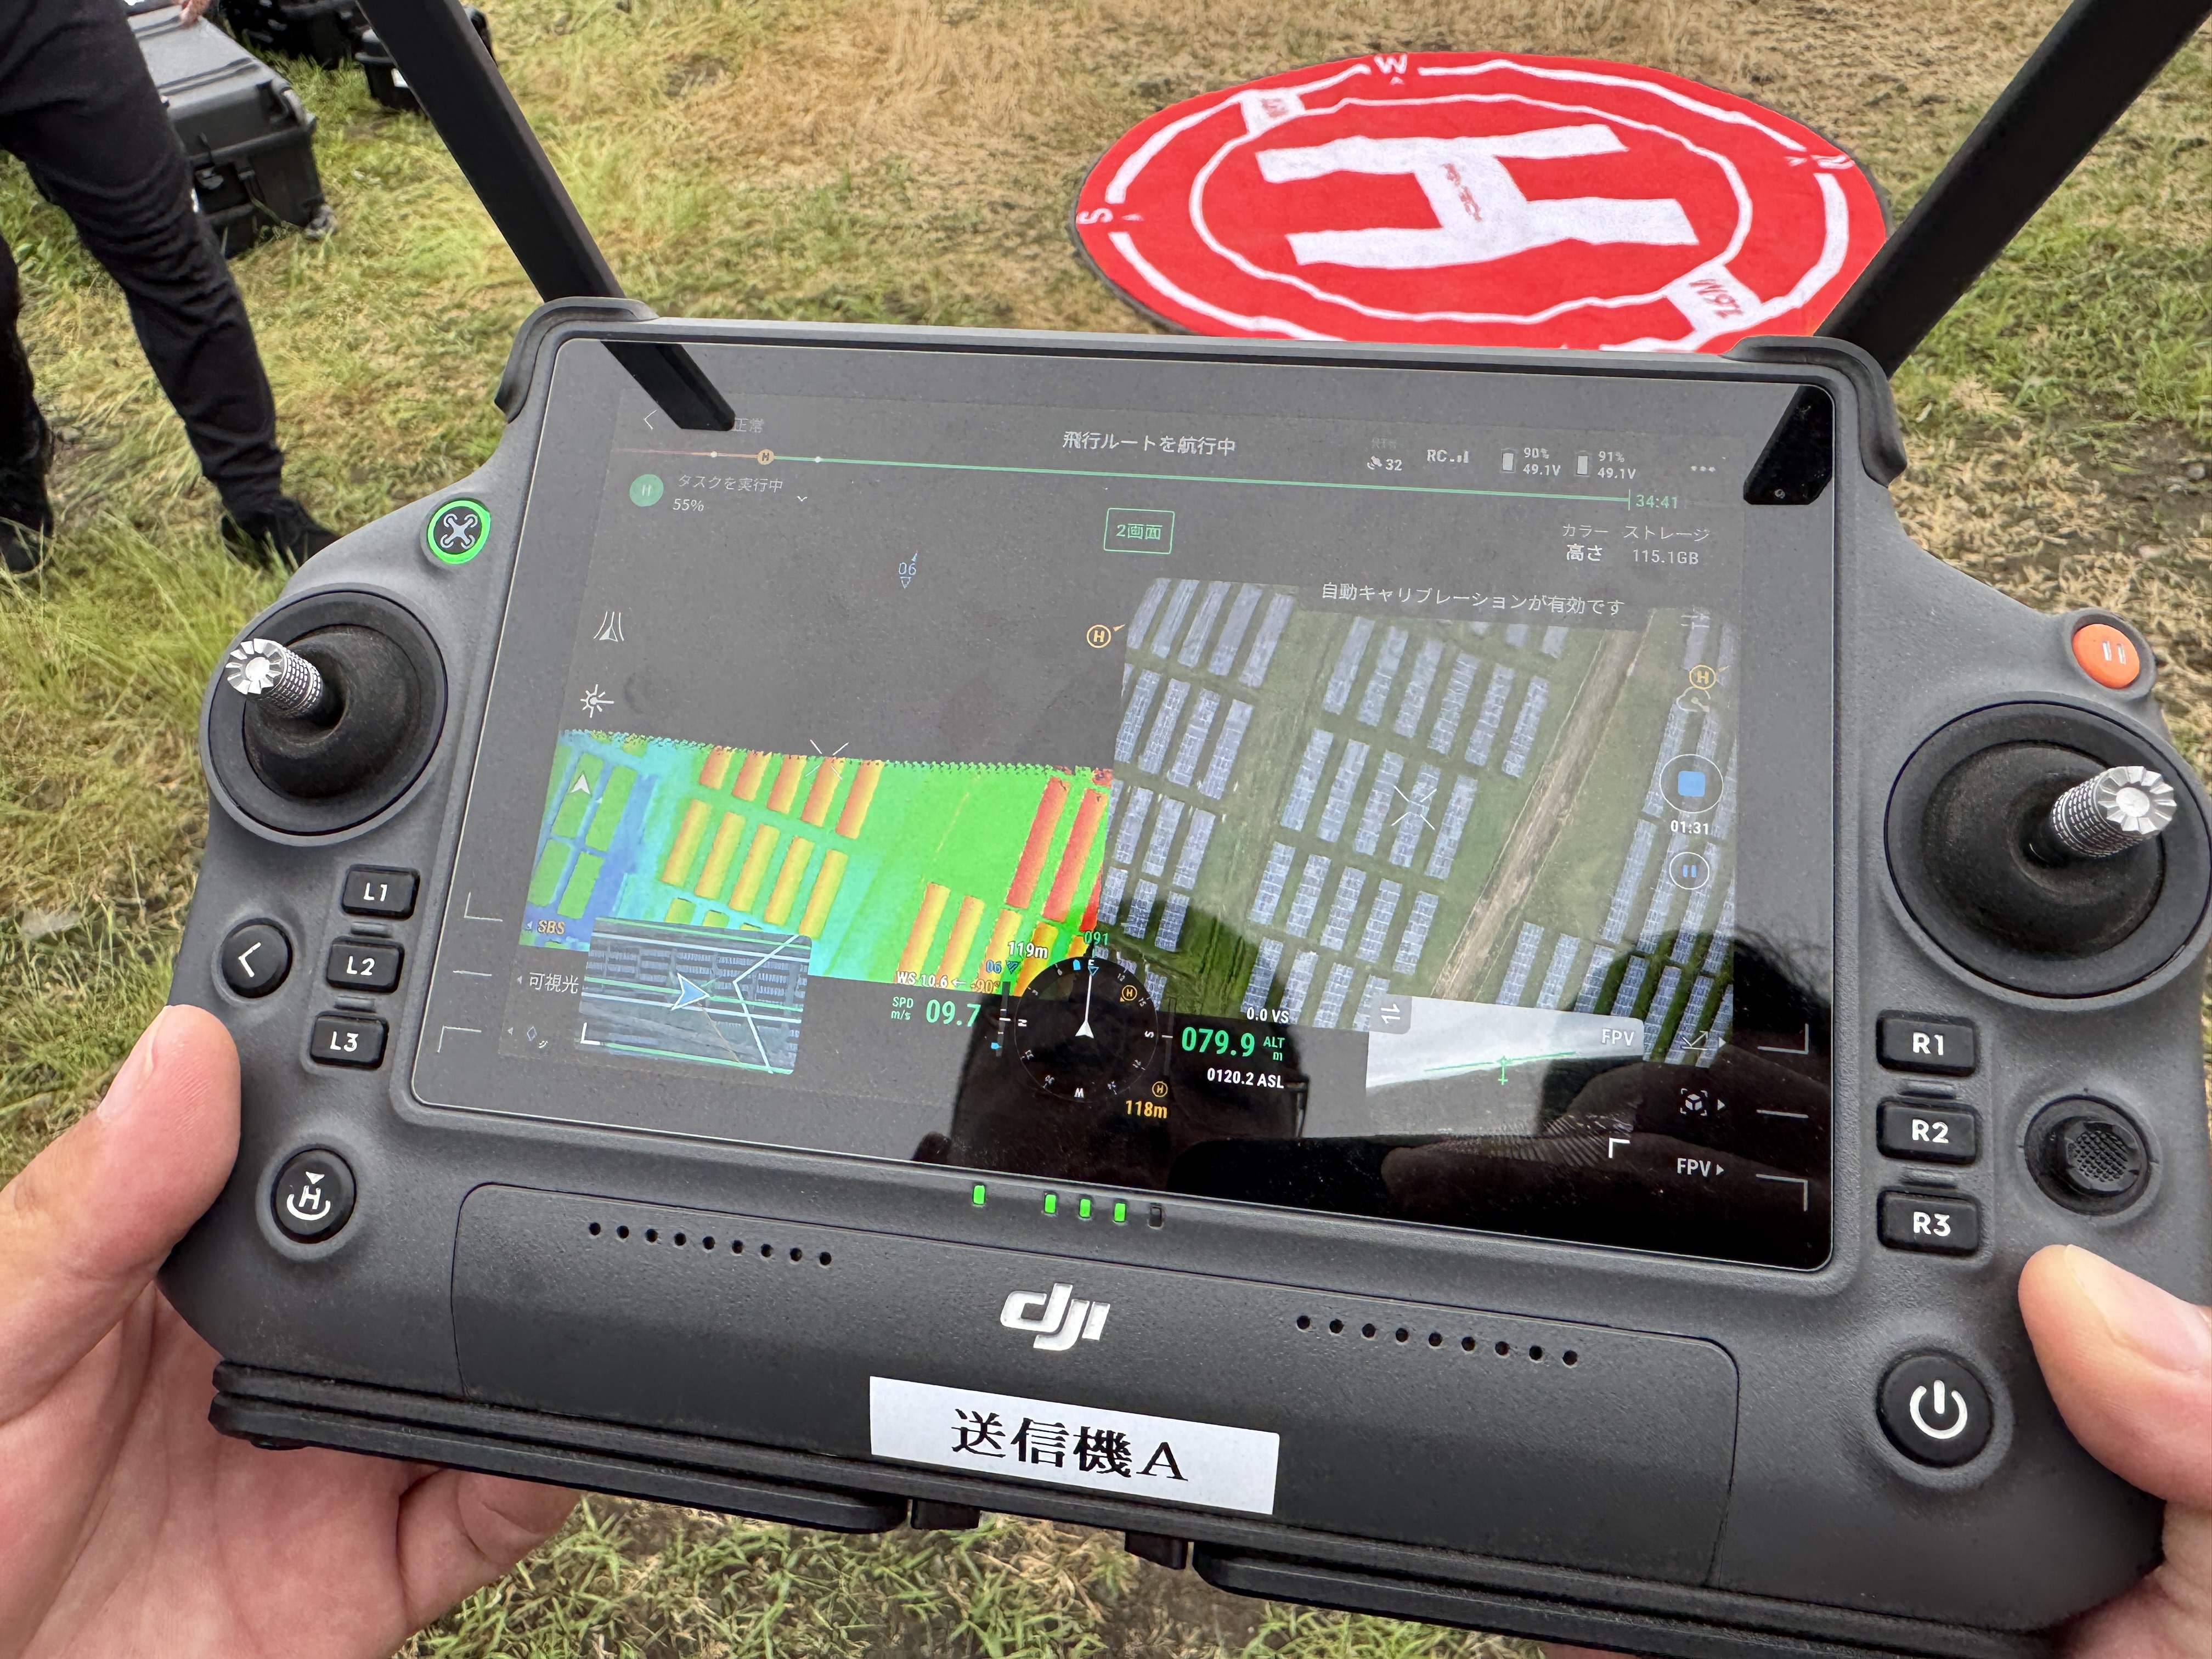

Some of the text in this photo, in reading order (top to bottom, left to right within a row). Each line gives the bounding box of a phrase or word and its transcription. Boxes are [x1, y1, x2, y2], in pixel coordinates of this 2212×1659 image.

[1373, 54, 1408, 74] W
[1254, 124, 1700, 269] H
[1076, 208, 1113, 224] S
[1063, 431, 1236, 456] 飛行ルートを航行中
[1427, 449, 1447, 462] RC
[1523, 447, 1550, 459] 90%
[1598, 451, 1624, 462] 91%
[1385, 459, 1402, 471] 32
[1523, 464, 1561, 476] 49.1V
[1598, 467, 1636, 479] 49.1V
[679, 475, 783, 493] タスクを実行中
[673, 498, 704, 511] 55%
[1635, 494, 1678, 509] 34:41
[1116, 523, 1163, 540] 2画面
[1562, 523, 1711, 541] カラー ストレージ
[1566, 543, 1699, 565] 高さ 115.1GB
[899, 562, 917, 575] 06
[1322, 582, 1626, 616] 自動キャリブレーションが有効です
[1671, 820, 1709, 834] 01:31
[363, 882, 388, 902] L1
[537, 919, 566, 935] SBS
[1084, 931, 1109, 945] 091
[1007, 941, 1048, 959] 119m
[346, 956, 375, 976] L2
[986, 961, 1002, 973] 06
[529, 972, 579, 995] 可視光
[896, 971, 948, 988] WS 10.6
[892, 996, 914, 1008] SPD
[891, 1010, 911, 1021] m/s
[926, 999, 981, 1027] 09.7
[1246, 1007, 1289, 1024] 0.0 VS
[330, 1031, 359, 1052] L3
[1181, 1026, 1255, 1057] 079.9
[1263, 1036, 1285, 1049] ALT
[1601, 1028, 1636, 1047] FPV
[1912, 1032, 1944, 1056] R1
[1272, 1052, 1283, 1061] m
[1207, 1068, 1284, 1089] 0120.2 ASL
[1074, 1087, 1085, 1098] W
[1126, 1099, 1168, 1119] 118m
[1911, 1119, 1949, 1144] R2
[1677, 1157, 1712, 1179] FPV
[1912, 1211, 1951, 1237] R3
[951, 1408, 1189, 1482] 送信機A
